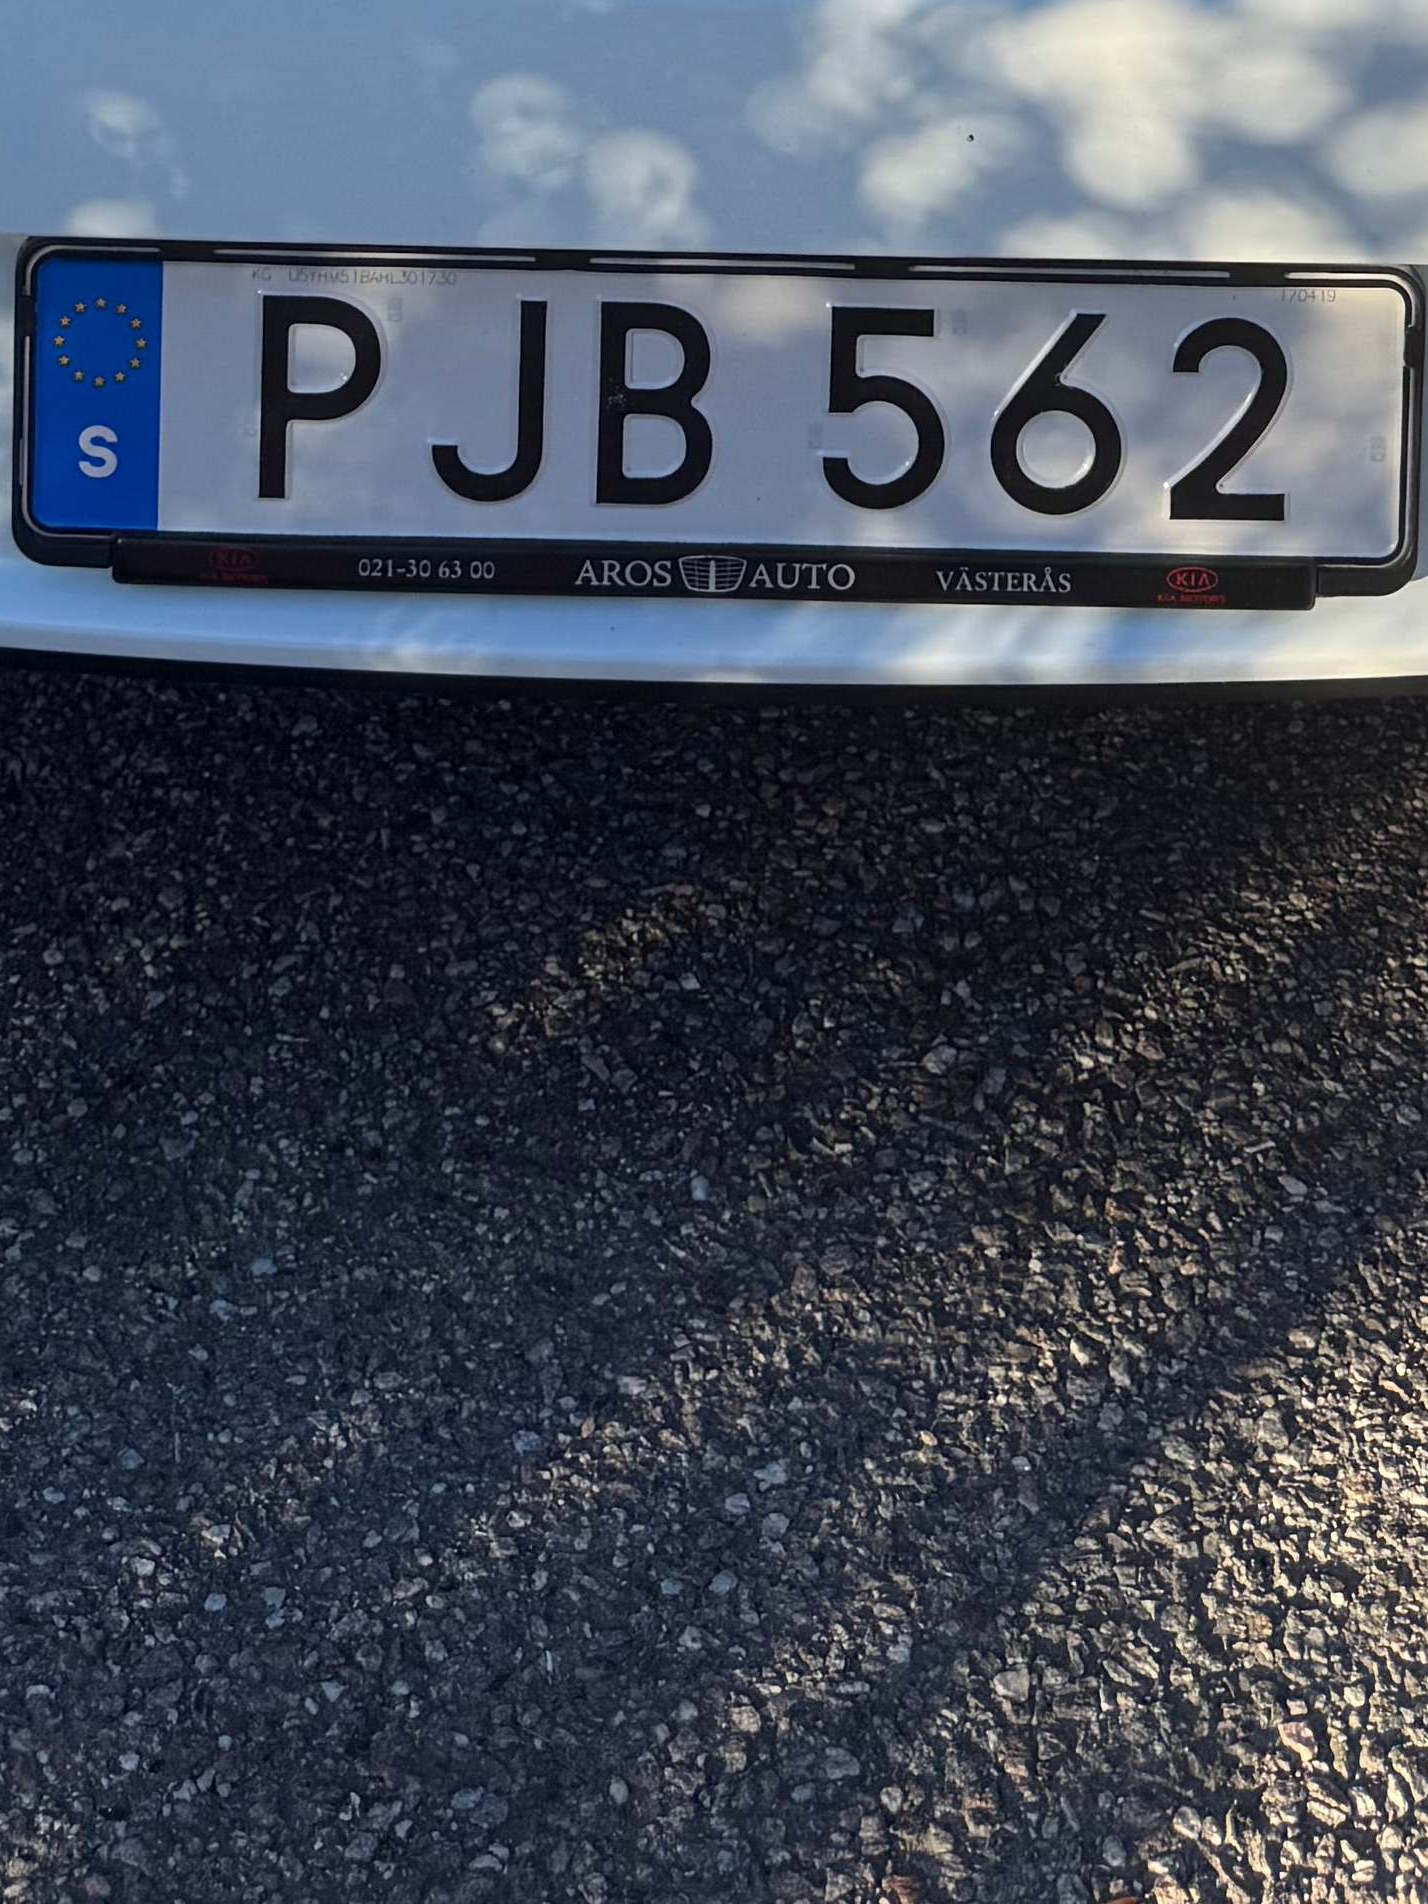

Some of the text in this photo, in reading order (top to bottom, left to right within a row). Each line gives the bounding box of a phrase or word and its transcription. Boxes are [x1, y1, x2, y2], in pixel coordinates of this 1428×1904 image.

[257, 294, 1289, 522] PJB 562
[78, 423, 118, 478] S
[358, 558, 495, 579] 021-30 63 00
[575, 559, 856, 590] AROS AUTO
[936, 567, 1071, 592] VÄSTERÅS
[1176, 573, 1209, 586] KIA
